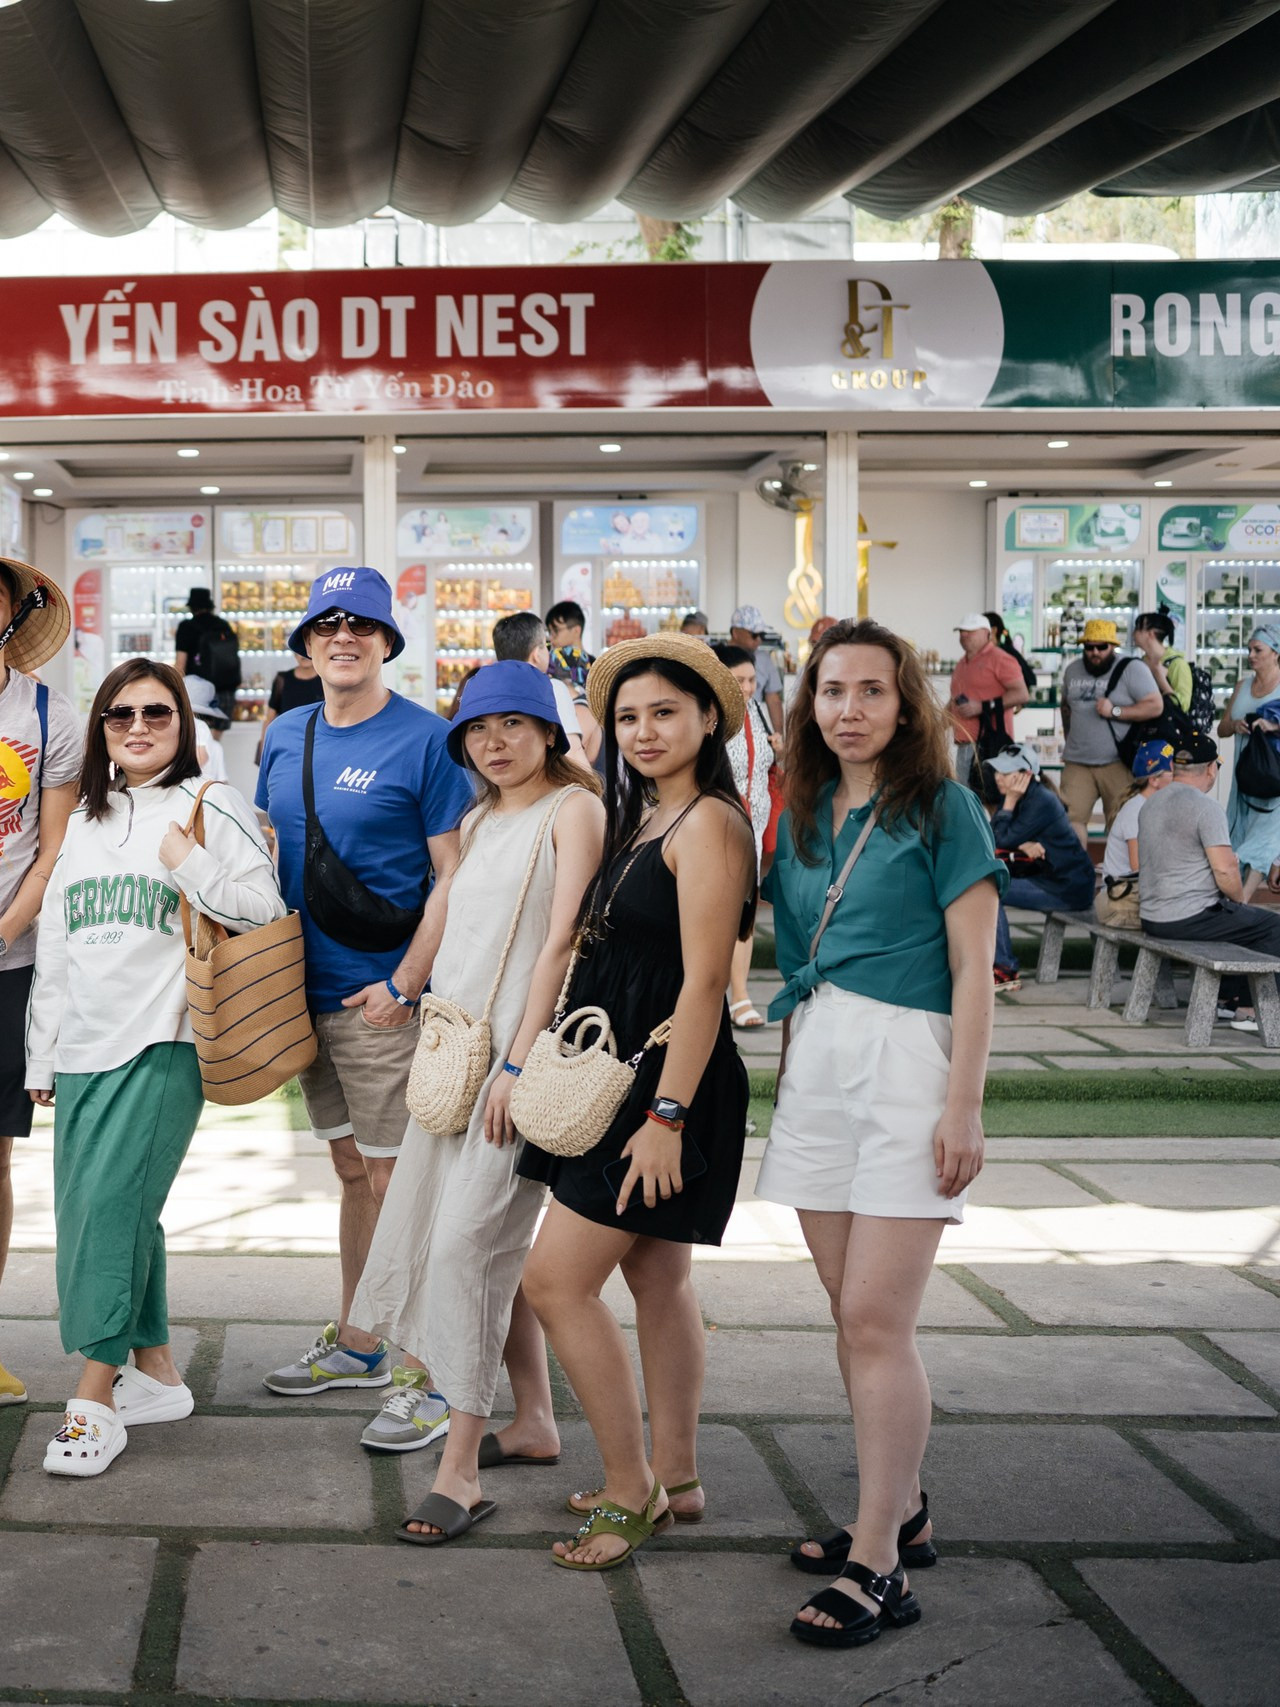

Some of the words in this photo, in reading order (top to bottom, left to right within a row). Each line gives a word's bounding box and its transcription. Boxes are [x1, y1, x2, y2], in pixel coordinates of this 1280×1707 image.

[59, 283, 177, 365] YẾN
[199, 286, 319, 363] SÀO
[340, 296, 415, 359] DT
[436, 293, 595, 358] NEST
[1110, 292, 1280, 357] RONG
[157, 380, 230, 405] Tinh
[240, 378, 302, 403] Hoa
[362, 371, 422, 400] Yến
[431, 370, 494, 399] Đảo
[831, 368, 927, 391] GROUP
[322, 571, 356, 592] MH
[336, 766, 377, 790] MH
[64, 873, 181, 937] ERMONT
